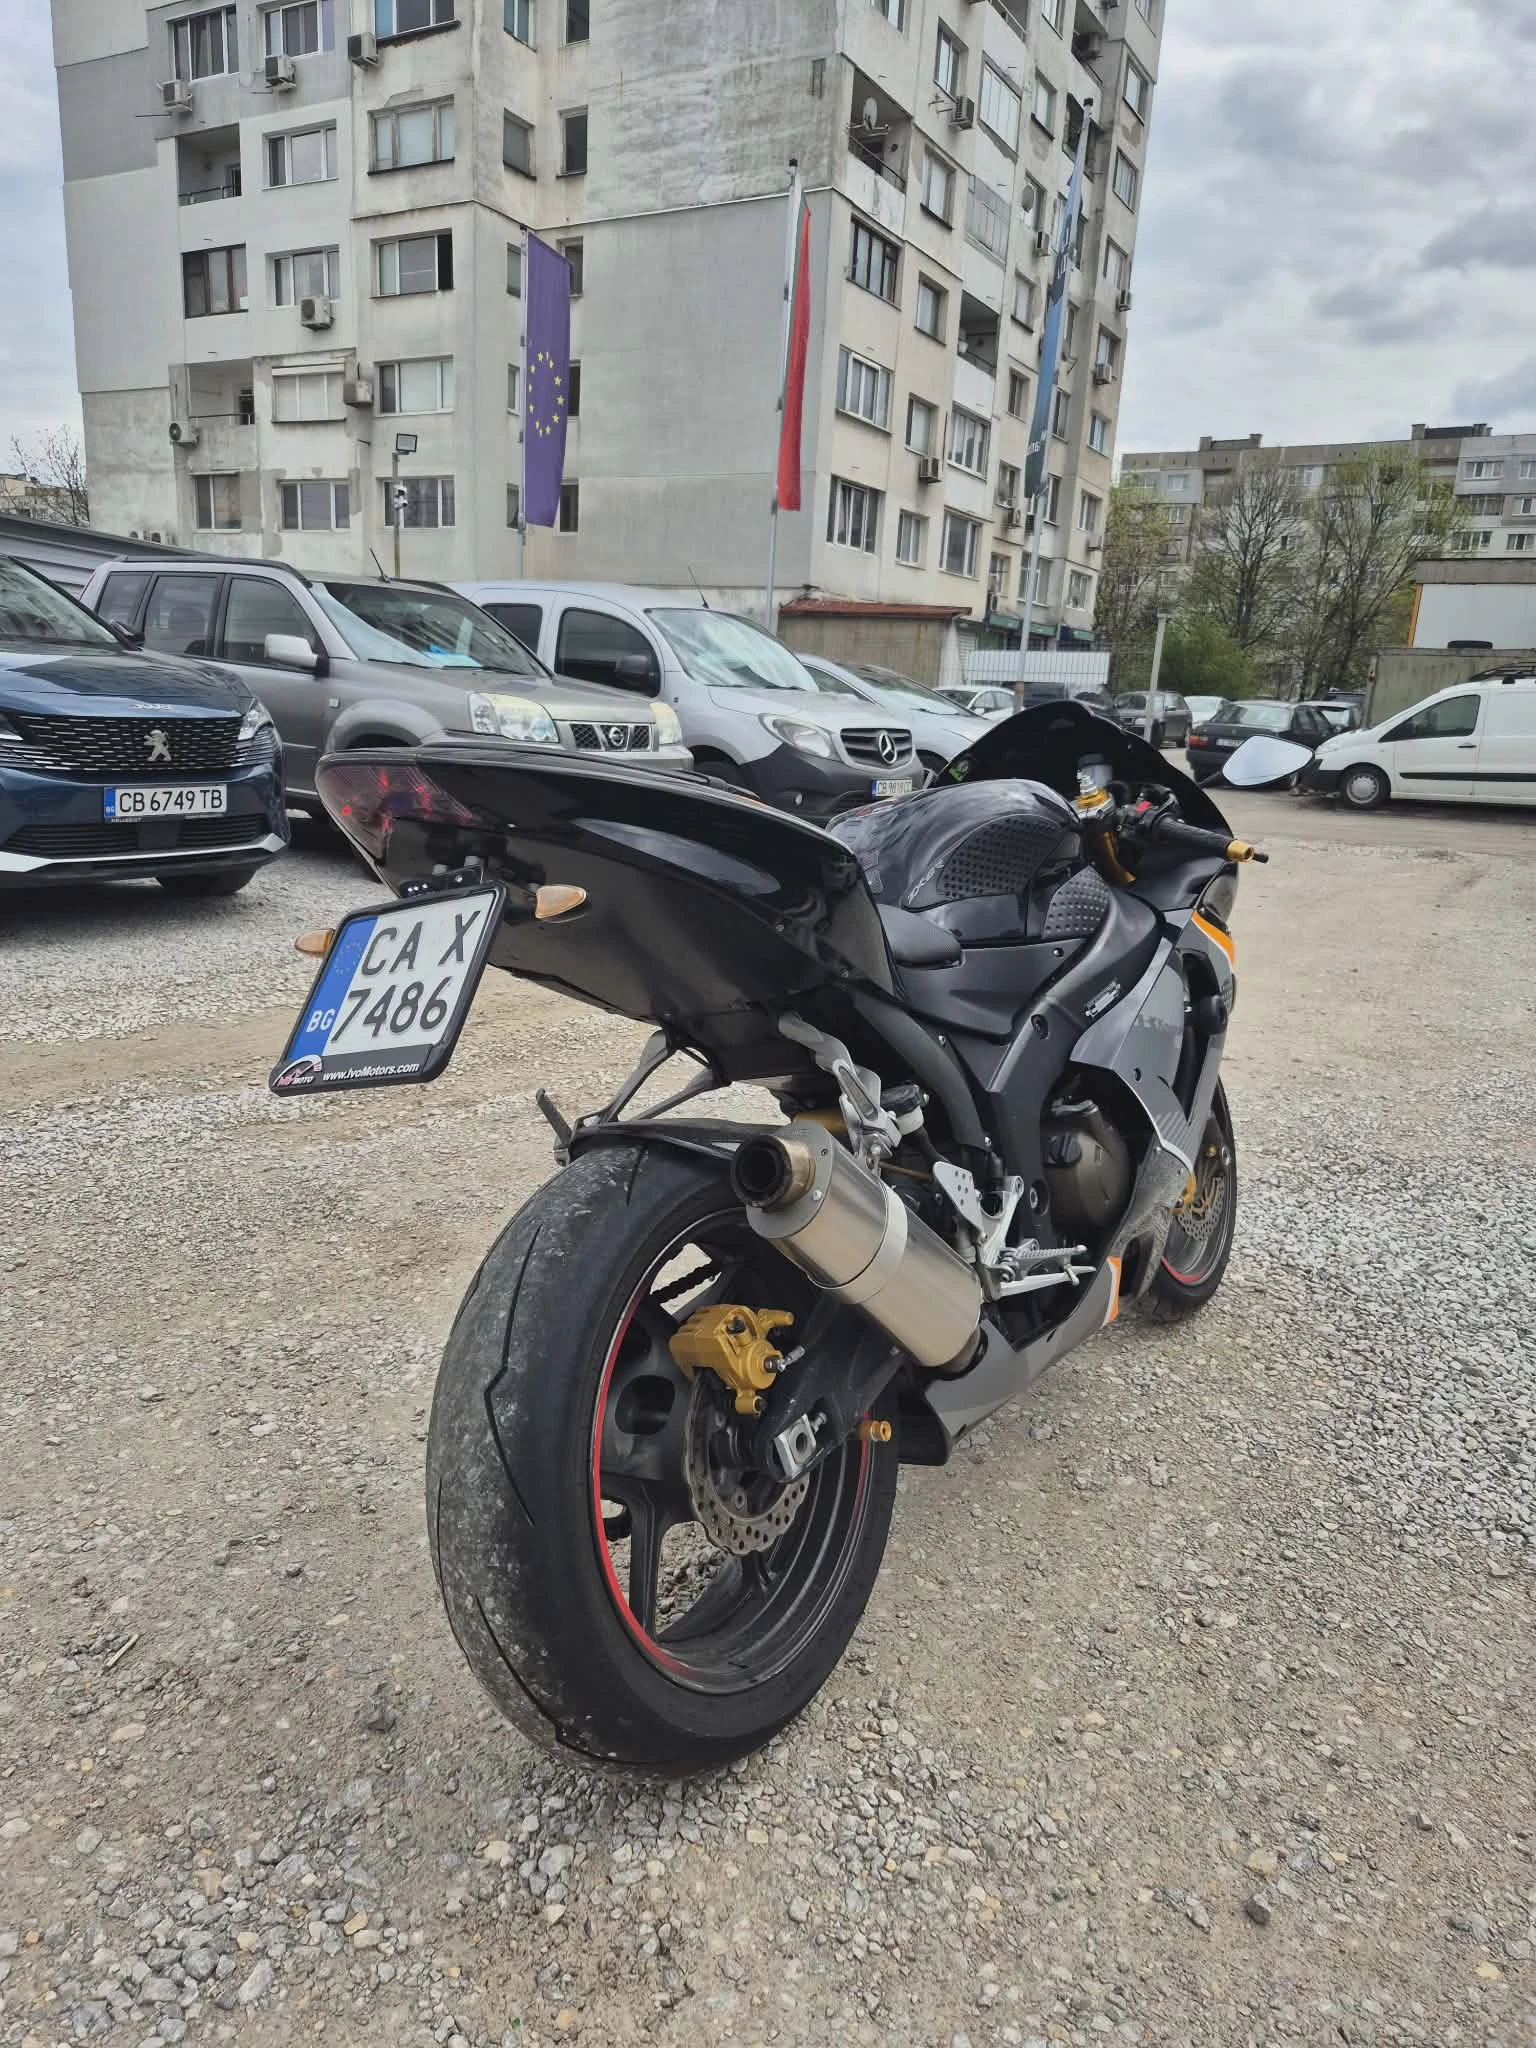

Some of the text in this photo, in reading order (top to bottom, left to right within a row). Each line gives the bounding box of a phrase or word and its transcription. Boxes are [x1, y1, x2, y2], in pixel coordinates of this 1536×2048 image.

[119, 789, 223, 812] CB 6749 TB
[361, 910, 481, 976] CA X
[306, 1008, 337, 1033] BG
[331, 976, 453, 1043] 7486
[322, 1063, 420, 1081] www.IvoMotors.com
